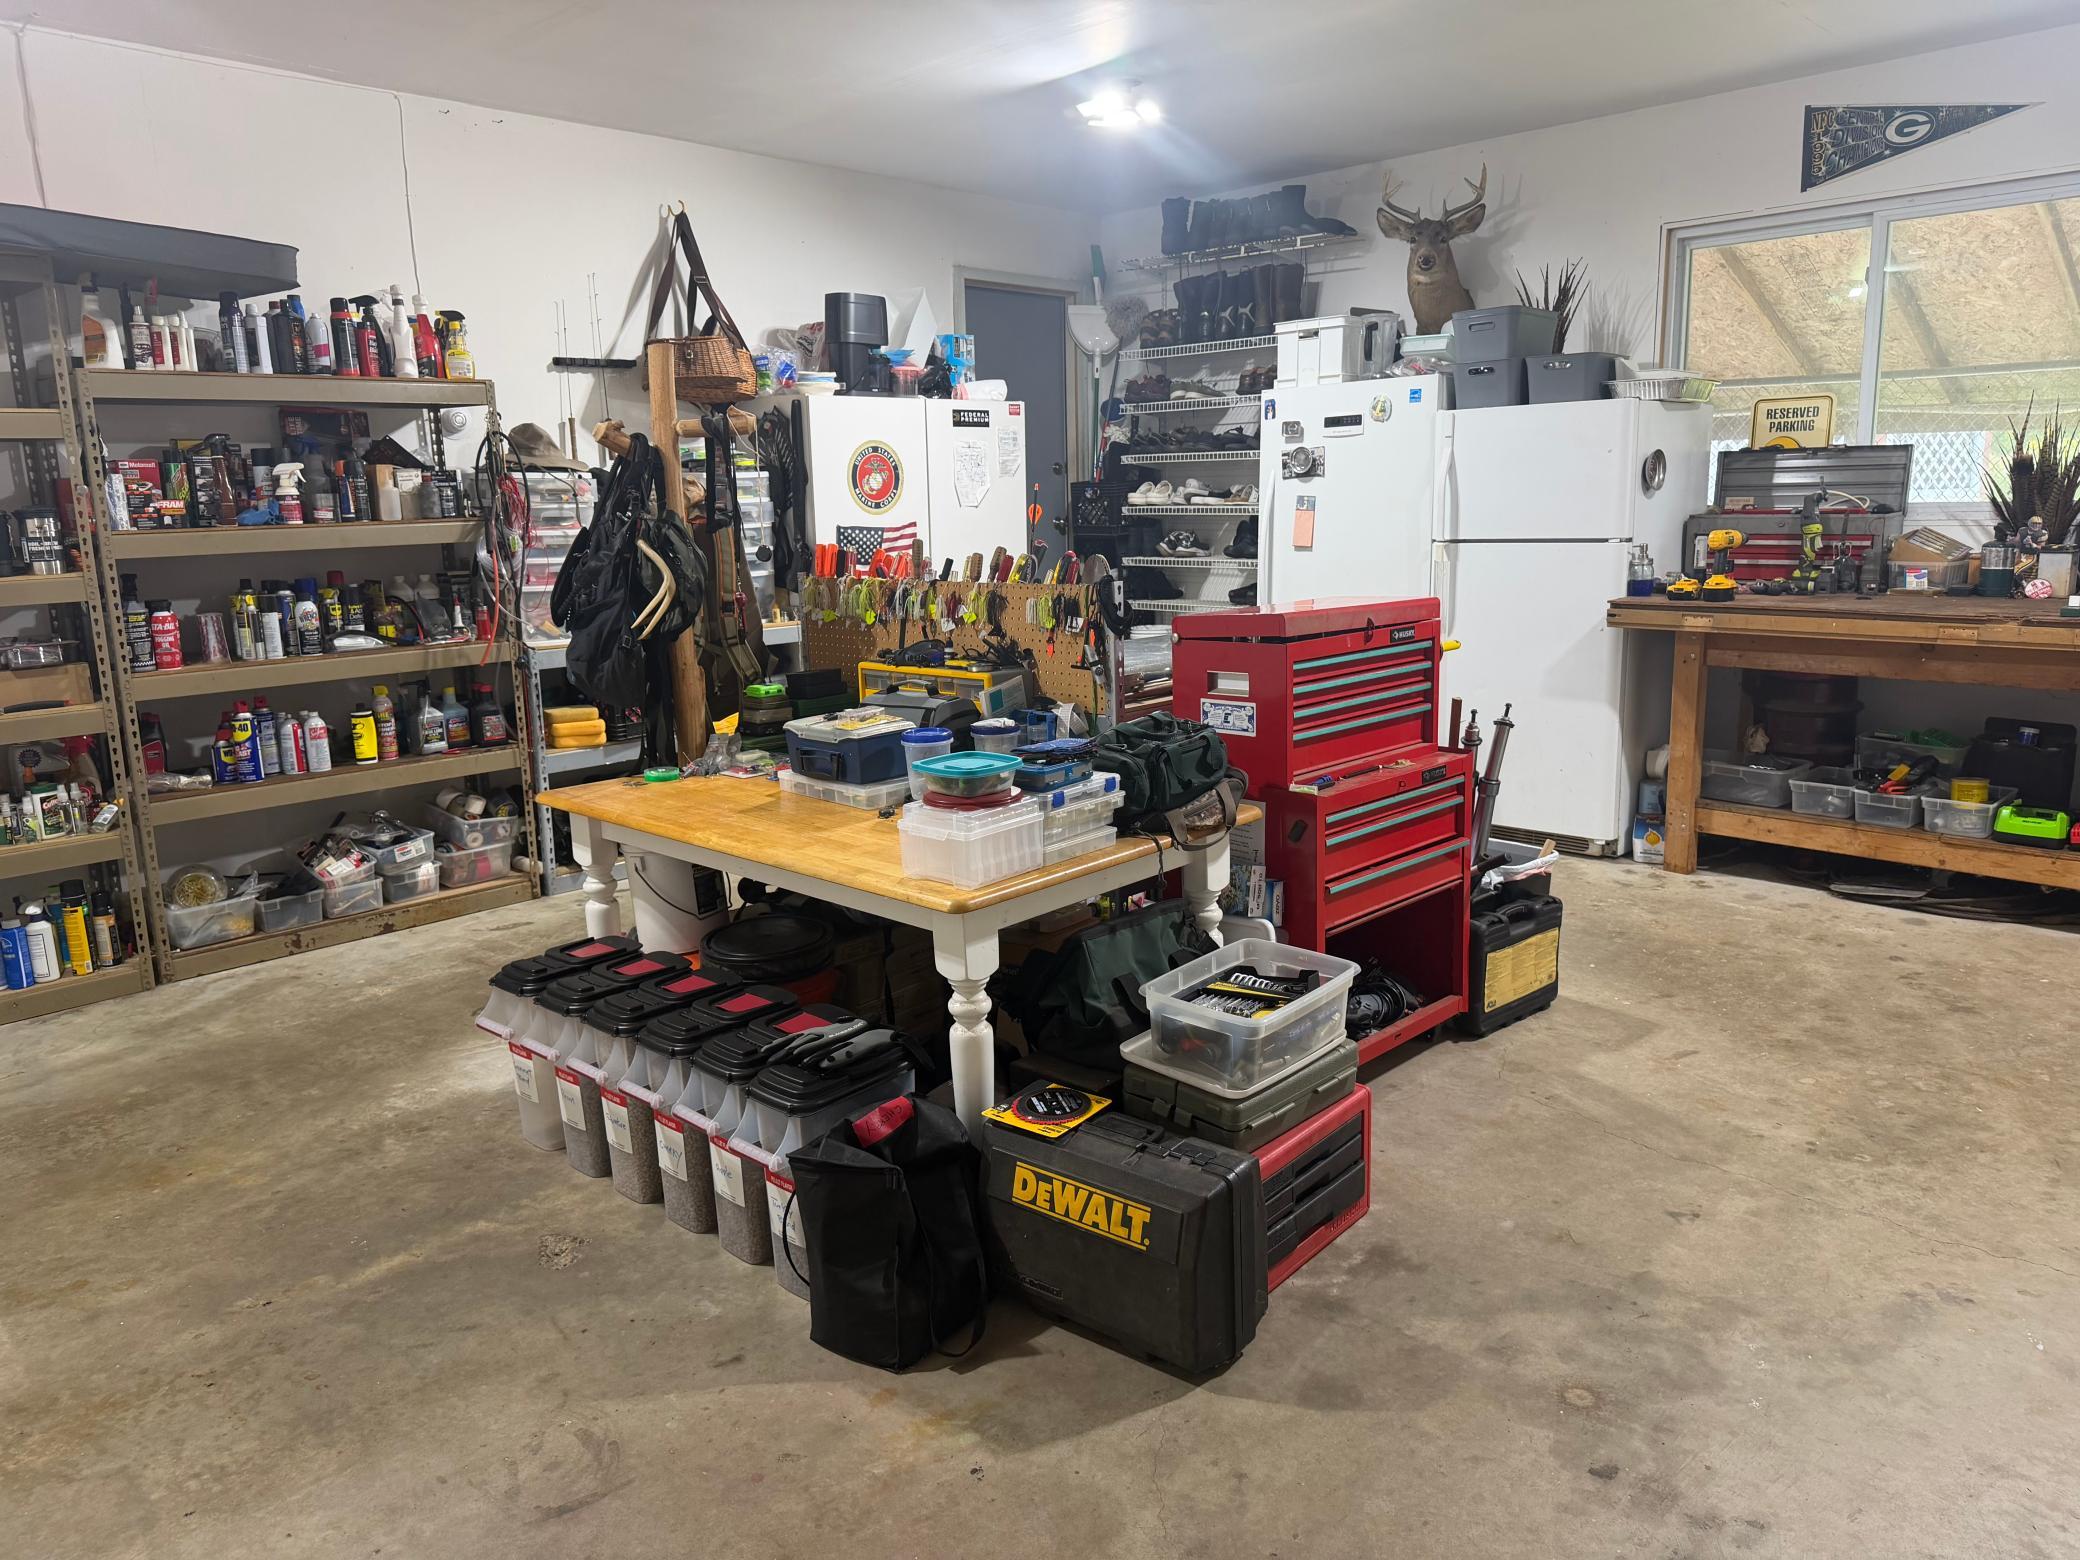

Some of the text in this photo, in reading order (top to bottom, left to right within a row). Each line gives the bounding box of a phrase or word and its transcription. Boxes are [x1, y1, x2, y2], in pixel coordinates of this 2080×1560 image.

[1811, 109, 1885, 132] NFC CENTRAL
[1828, 124, 1884, 148] DIVISION
[1766, 405, 1820, 420] RESERVED
[1768, 419, 1815, 433] PARKING
[854, 447, 896, 466] UNITED STATES
[156, 500, 184, 509] FRAM
[854, 488, 898, 508] MARINE CORPS
[1399, 629, 1415, 639] HUSKY
